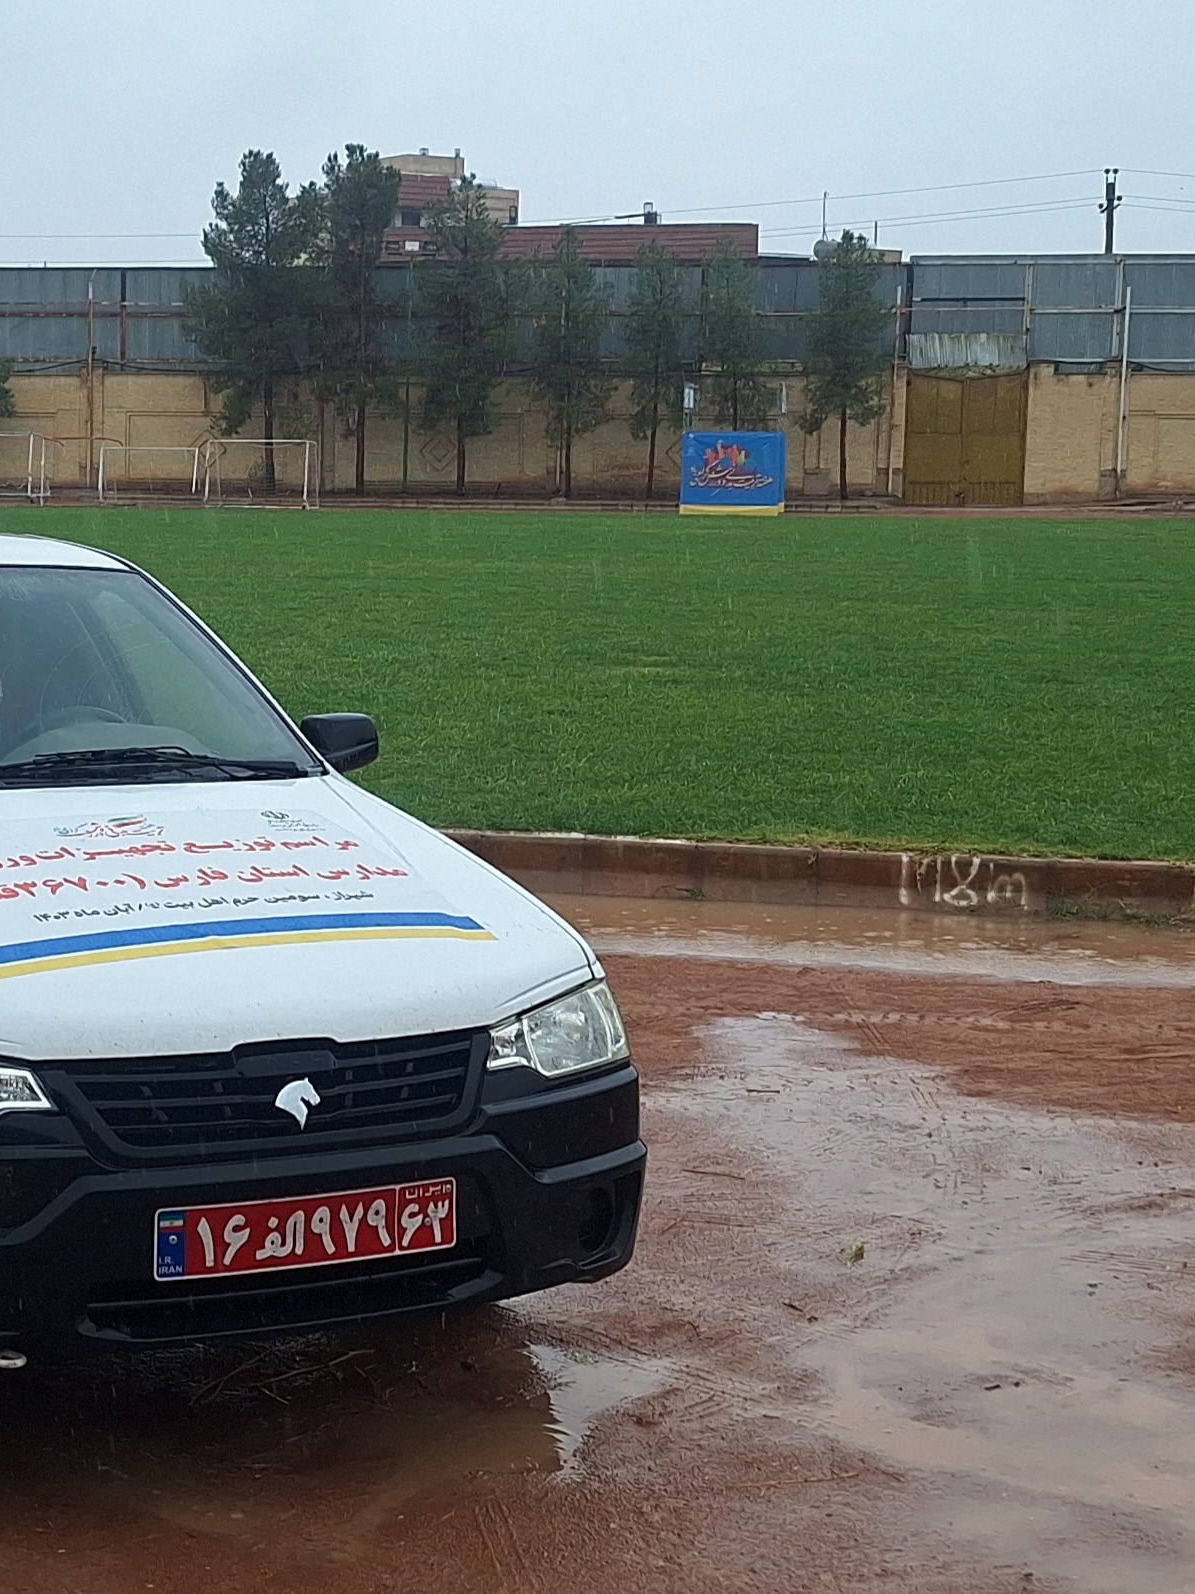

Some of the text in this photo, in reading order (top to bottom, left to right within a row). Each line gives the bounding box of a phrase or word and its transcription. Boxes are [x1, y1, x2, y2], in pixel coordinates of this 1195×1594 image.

[183, 836, 278, 854] توزیع
[280, 836, 360, 850] مراسم
[35, 841, 177, 861] تجهیزات
[154, 866, 230, 888] فارس
[237, 864, 310, 883] استان
[317, 863, 409, 881] مدارس
[198, 897, 229, 908] اهل
[233, 896, 259, 907] حرم
[264, 893, 320, 904] سومین
[104, 903, 135, 916] آبان
[164, 901, 194, 910] بیت
[33, 911, 70, 923] ۱۴۰۳
[74, 908, 101, 918] ماه
[405, 1184, 446, 1200] ایران
[400, 1199, 450, 1248] ۶۳
[158, 1265, 182, 1275] IRAN
